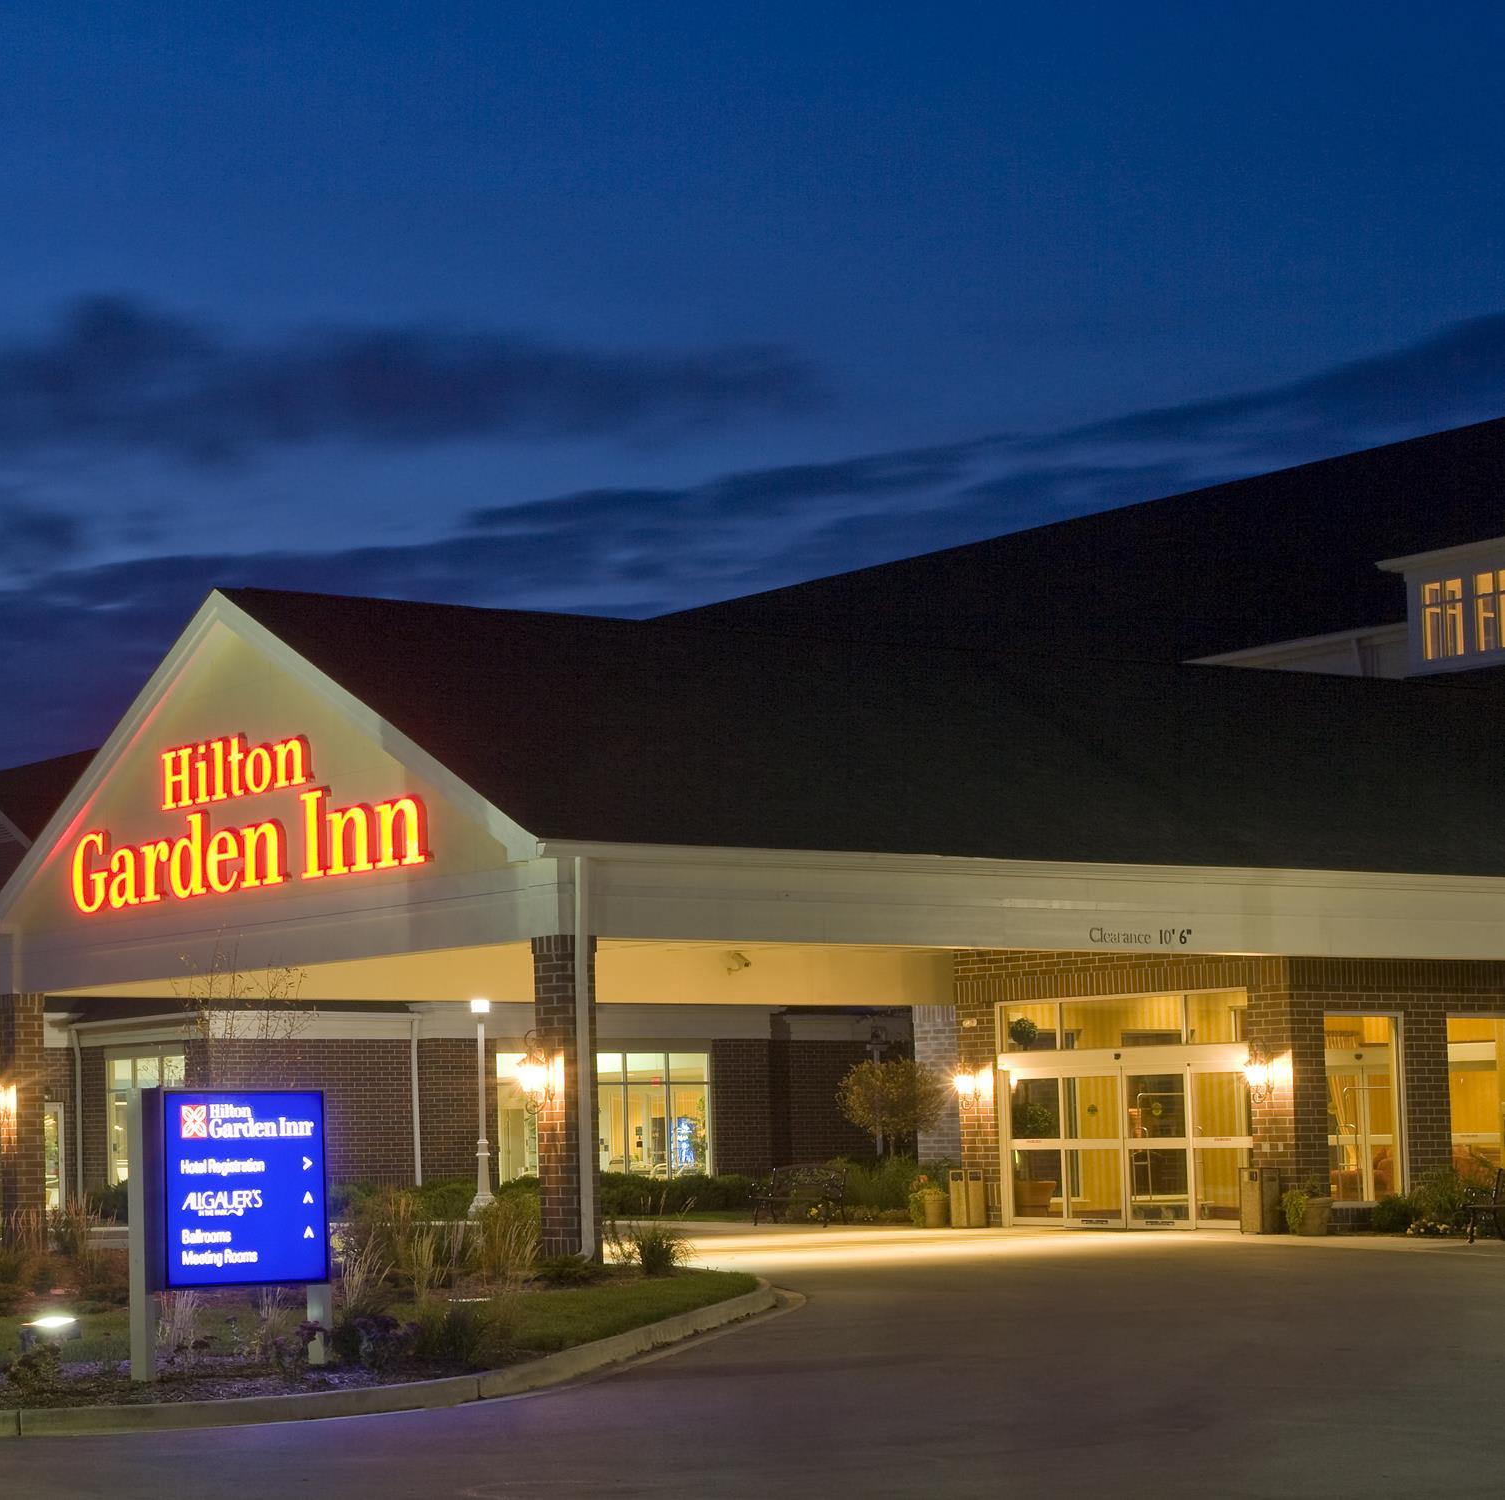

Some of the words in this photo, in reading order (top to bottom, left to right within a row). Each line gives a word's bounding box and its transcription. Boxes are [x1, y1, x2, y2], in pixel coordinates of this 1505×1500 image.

[161, 734, 310, 811] Hilton
[71, 811, 286, 914] Garden
[299, 787, 426, 880] Inn
[1089, 927, 1151, 944] Clearance
[209, 1104, 252, 1118] Hilton
[209, 1118, 277, 1139] Garden
[279, 1117, 313, 1137] Inn
[180, 1159, 207, 1174] Hotel
[208, 1157, 265, 1176] Registration
[181, 1189, 263, 1210] ALLGAUER'S
[181, 1229, 232, 1244] Ballrooms
[181, 1250, 223, 1267] Meeting
[224, 1249, 258, 1263] Rooms
